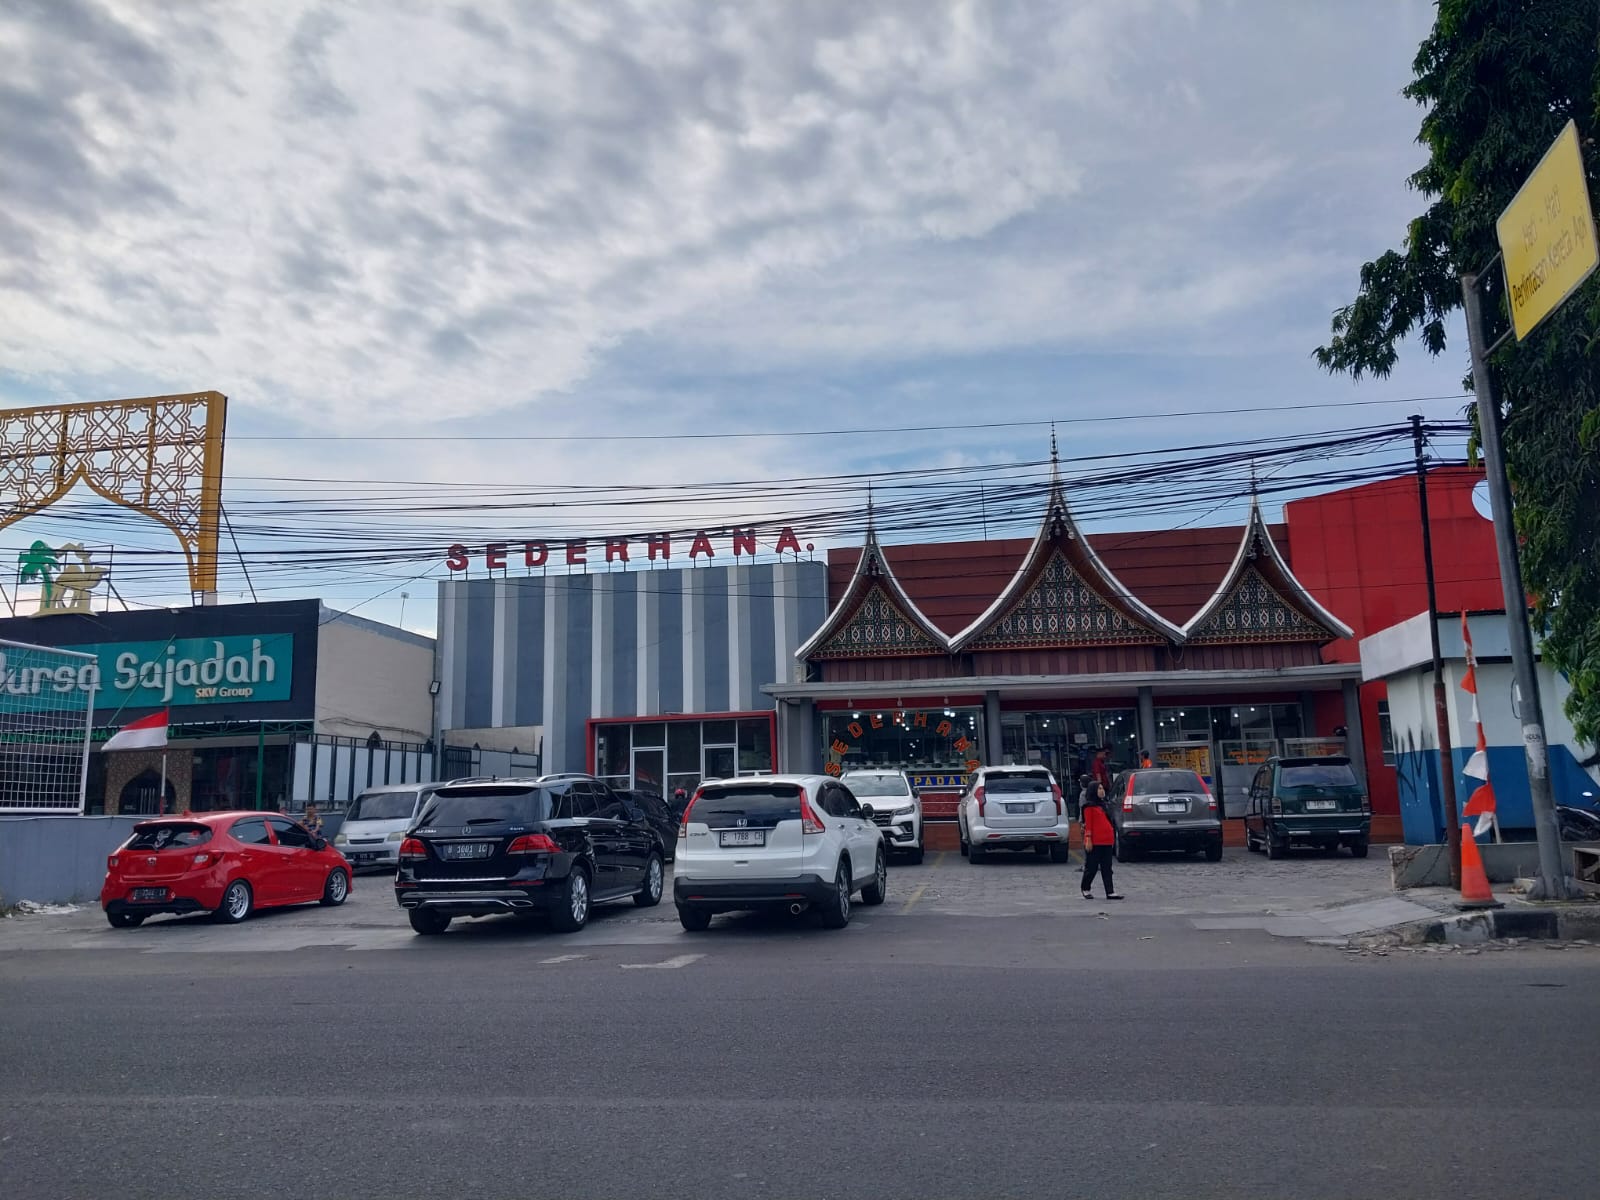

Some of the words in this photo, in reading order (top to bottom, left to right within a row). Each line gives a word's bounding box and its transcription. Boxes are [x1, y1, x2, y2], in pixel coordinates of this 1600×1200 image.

[1522, 212, 1538, 252] Hati
[1545, 184, 1561, 225] Hati
[1512, 256, 1548, 312] Perlintasan
[1548, 229, 1573, 273] Kereta
[1572, 206, 1587, 249] Api
[114, 639, 275, 702] Sajadah
[195, 687, 216, 698] SKV
[219, 686, 253, 697] Group
[824, 711, 981, 776] SEDERHANA
[722, 832, 727, 841] E
[754, 831, 763, 841] CH
